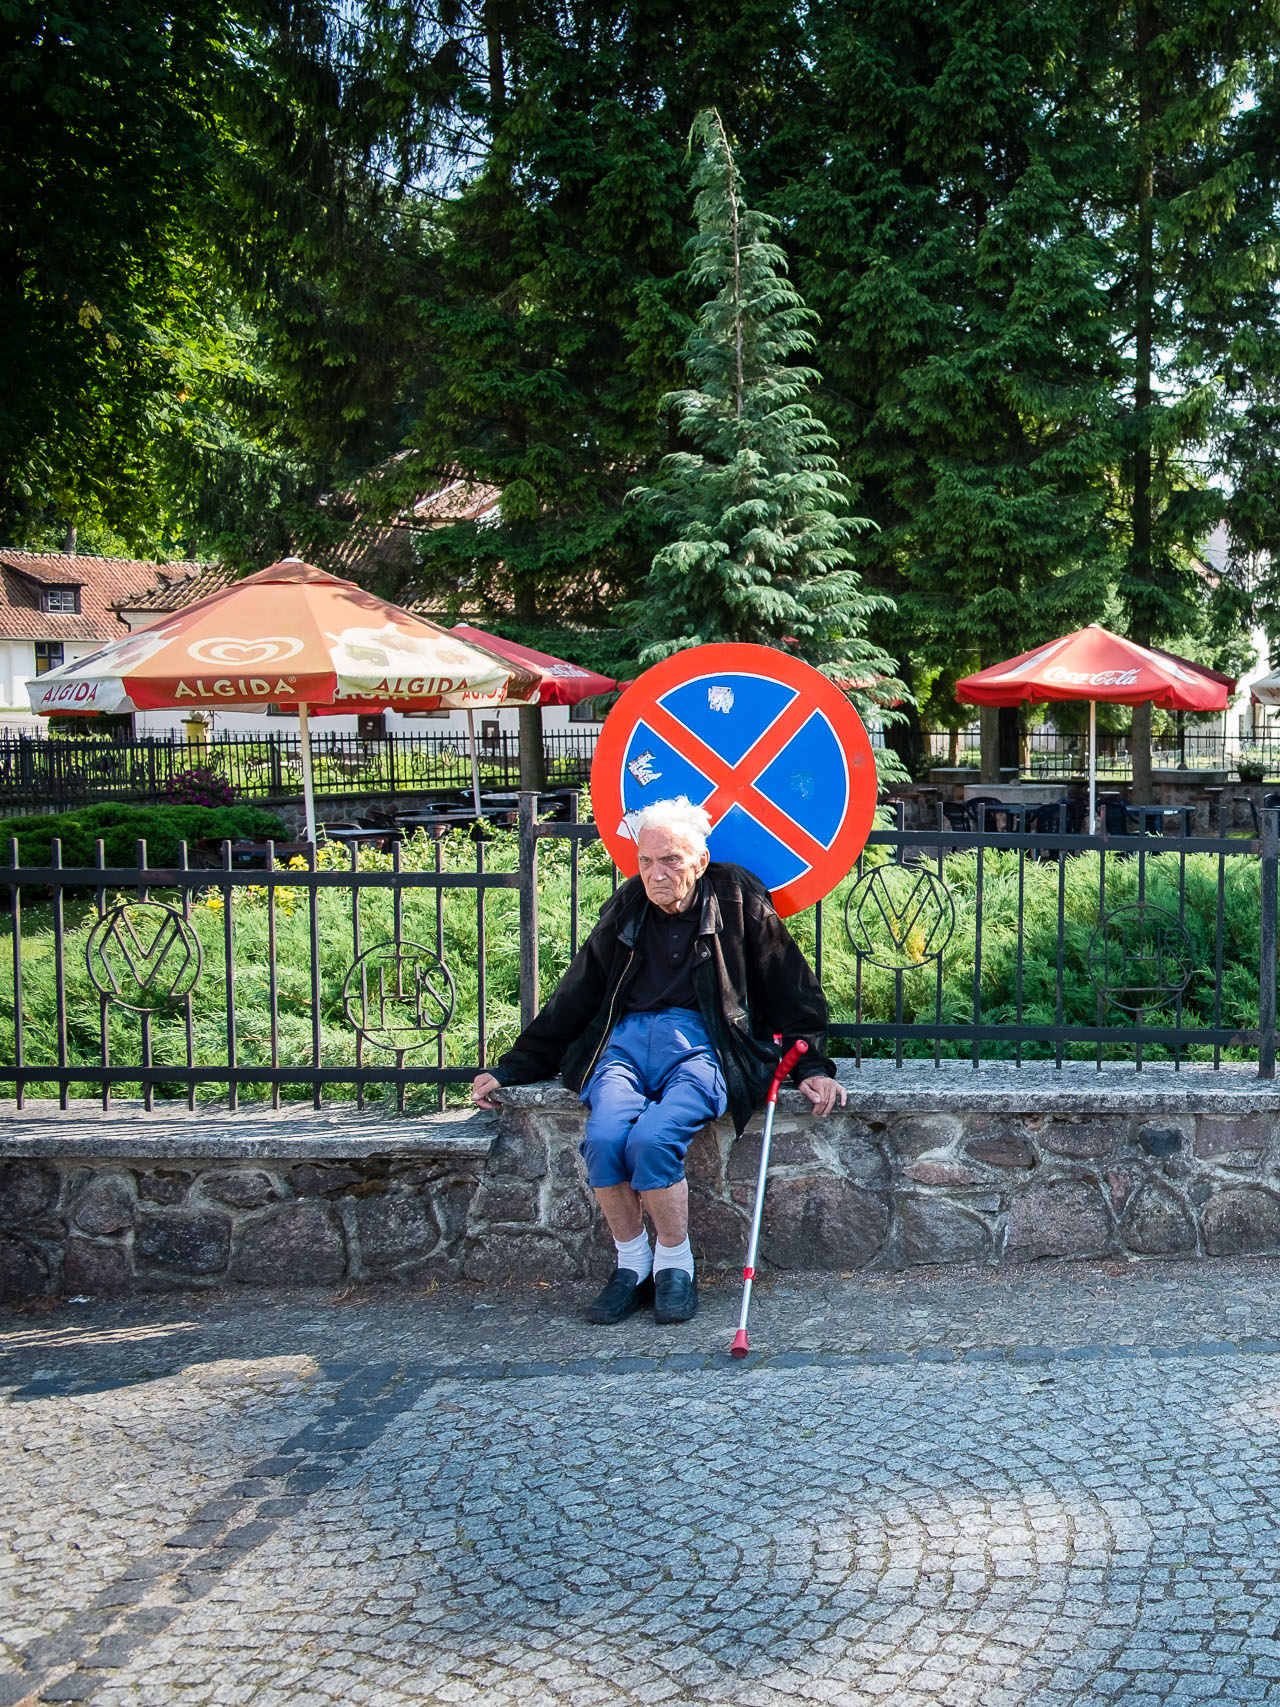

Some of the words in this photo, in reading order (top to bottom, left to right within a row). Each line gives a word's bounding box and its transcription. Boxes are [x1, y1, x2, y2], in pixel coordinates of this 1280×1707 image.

[370, 676, 470, 695] ALGIDA
[1042, 666, 1143, 687] Coca-Cola
[40, 681, 100, 705] ALGIDA
[174, 678, 297, 699] ALGIDA
